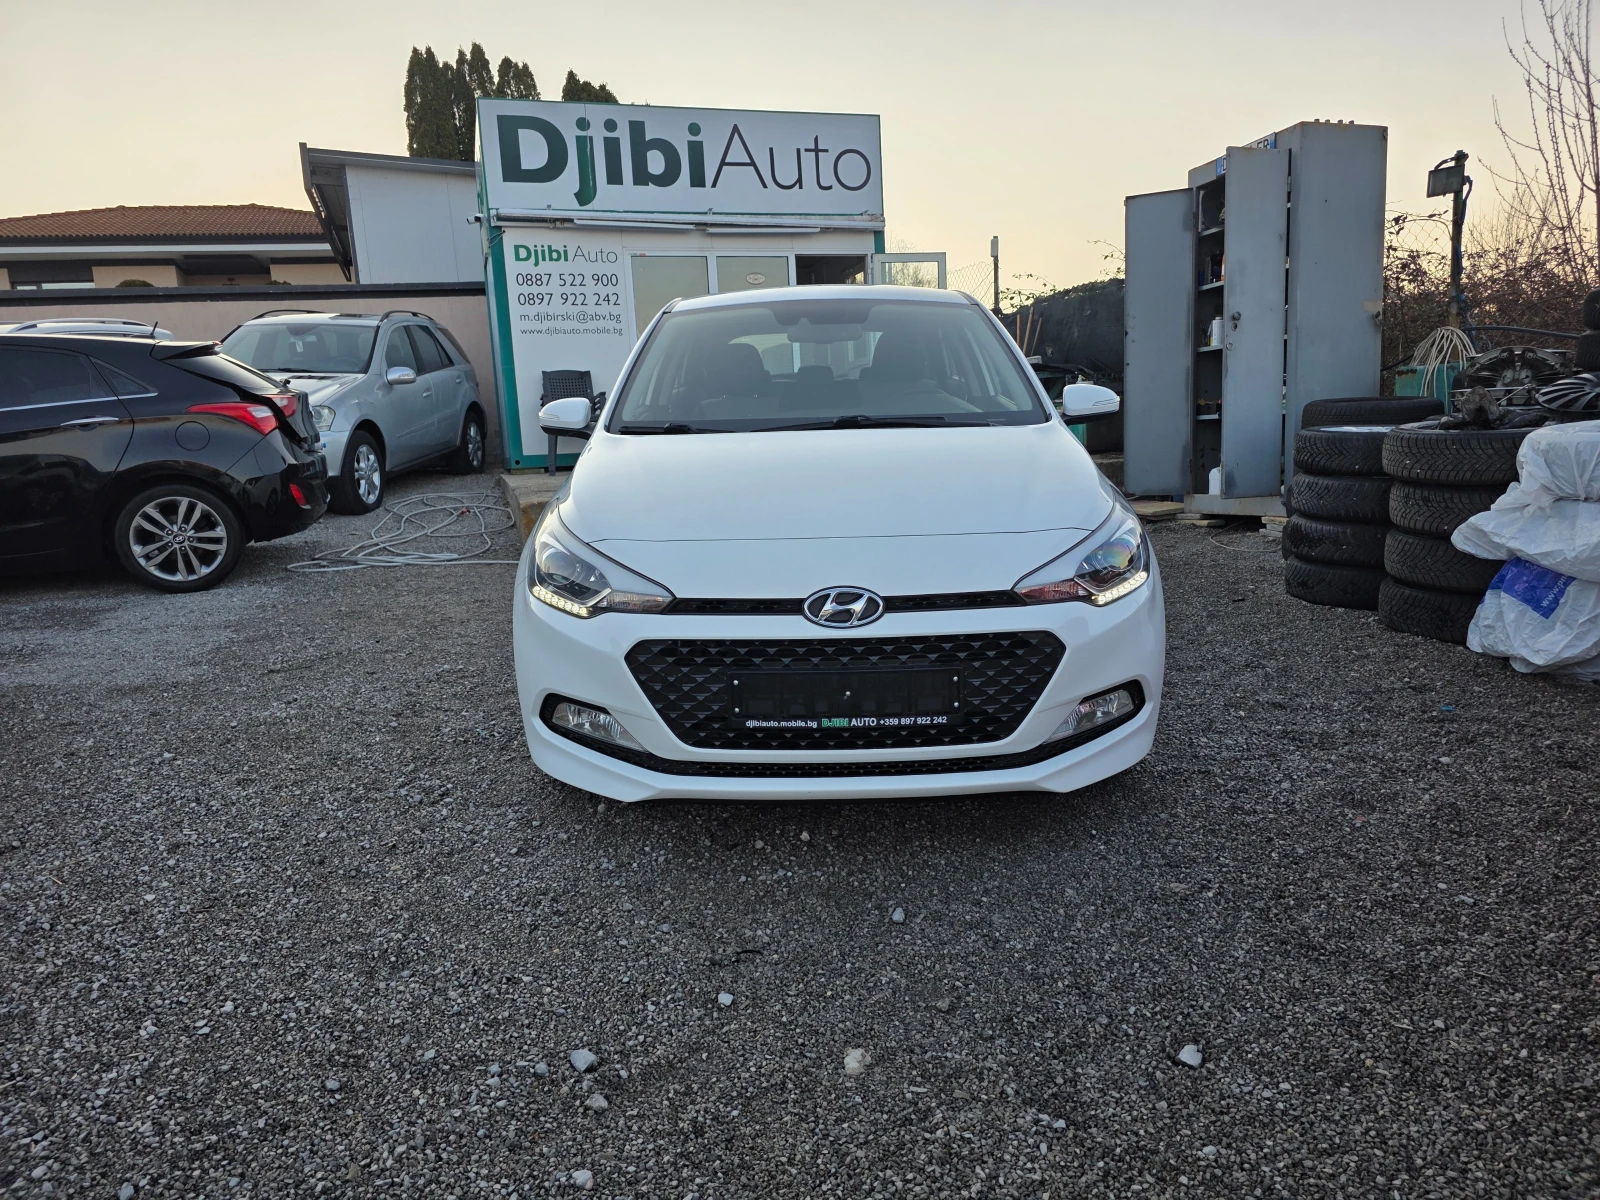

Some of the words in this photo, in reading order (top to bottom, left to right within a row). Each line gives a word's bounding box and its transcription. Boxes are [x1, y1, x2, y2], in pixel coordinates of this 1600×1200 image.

[513, 244, 569, 267] Djibi
[572, 245, 618, 263] Auto
[516, 272, 552, 286] 0887
[559, 273, 586, 287] 522
[592, 273, 619, 287] 900
[518, 292, 553, 306] 0897
[560, 292, 588, 306] 922
[593, 292, 621, 306] 242
[519, 310, 622, 324] m.djibirski@abv.bg
[519, 326, 624, 336] www.djibiauto.mobile.bg
[745, 719, 818, 729] djibiauto.mobile.bg
[821, 718, 849, 728] DJIBI
[850, 717, 877, 727] AUTO
[879, 717, 899, 726] +359
[900, 717, 915, 725] 897
[916, 716, 931, 725] 922
[932, 715, 948, 724] 242
